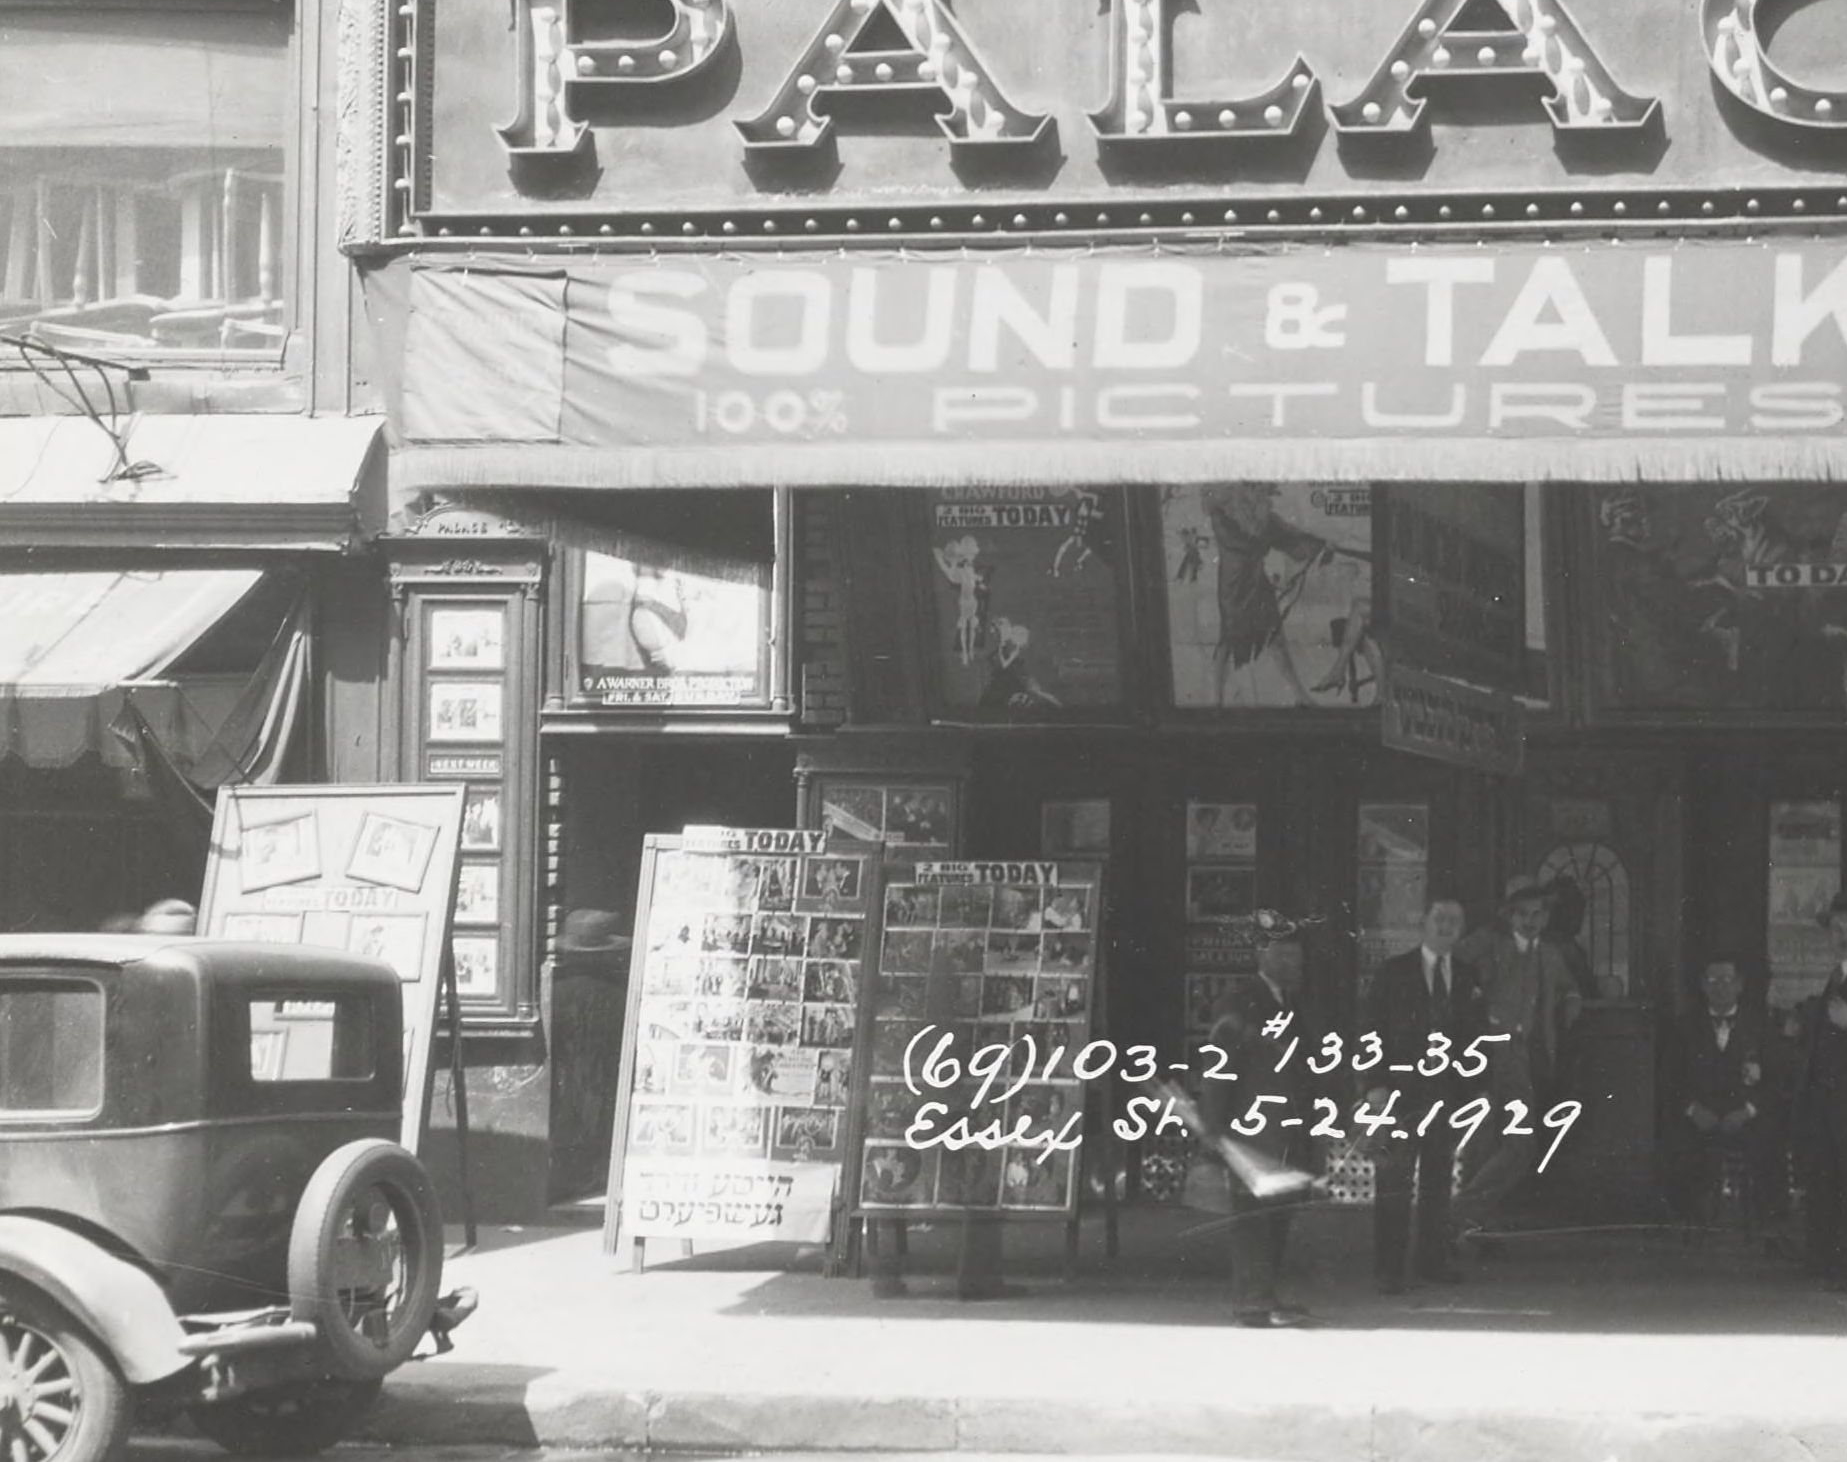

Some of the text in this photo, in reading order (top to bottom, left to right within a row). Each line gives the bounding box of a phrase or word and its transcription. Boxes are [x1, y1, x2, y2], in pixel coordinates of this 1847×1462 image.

[605, 261, 1203, 375] SOUND
[1264, 282, 1345, 350] &
[695, 387, 847, 434] 100%
[934, 380, 1842, 430] PICTURES
[993, 506, 1069, 526] TODAY
[607, 677, 655, 690] WARNER
[745, 831, 825, 853] TODAY
[917, 863, 1055, 885] FEATURES TODAY
